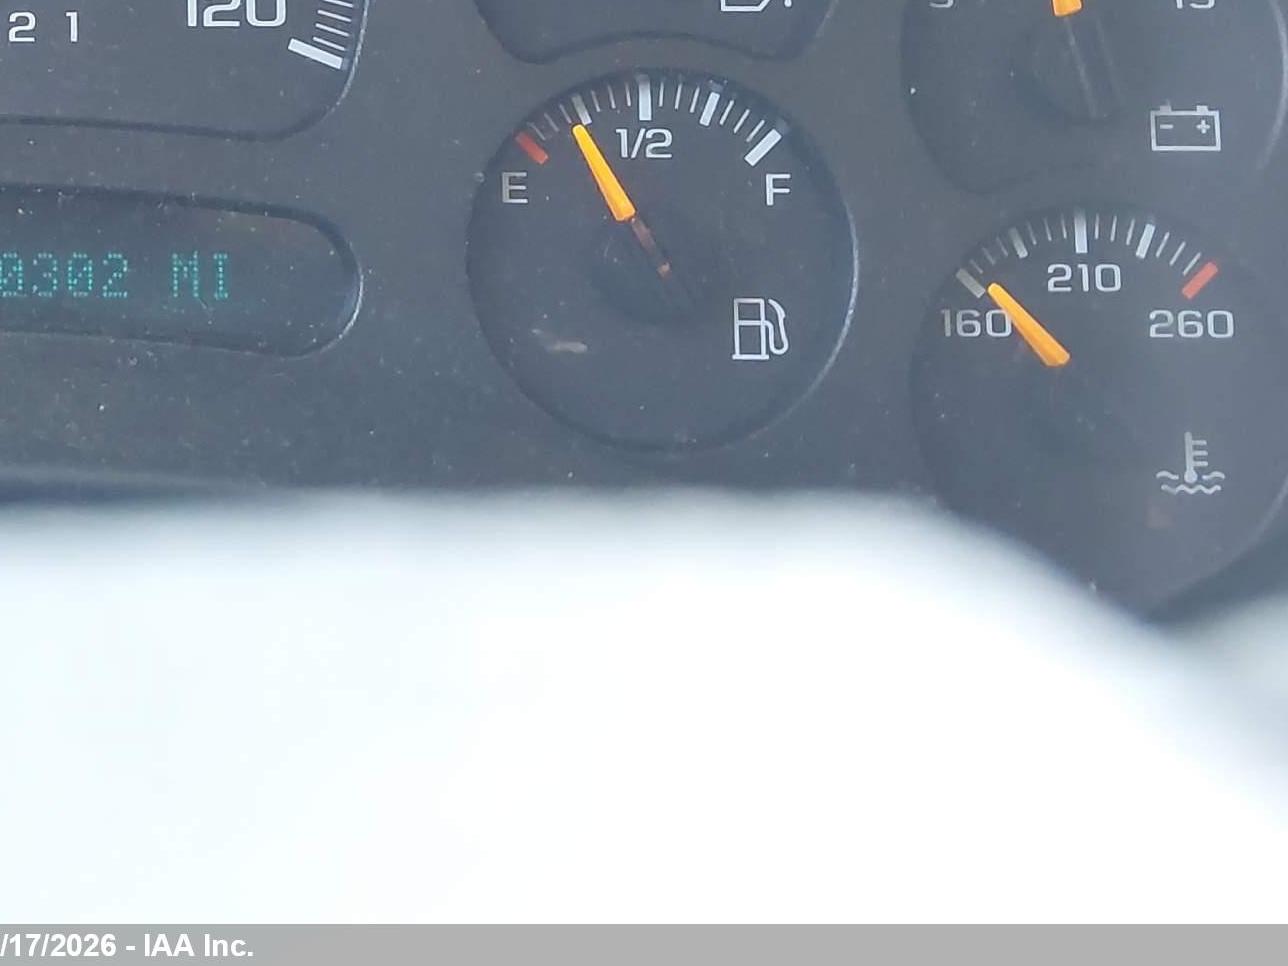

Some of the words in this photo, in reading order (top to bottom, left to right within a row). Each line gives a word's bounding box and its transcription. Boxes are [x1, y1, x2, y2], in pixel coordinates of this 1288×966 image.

[8, 11, 36, 43] 2
[65, 11, 78, 43] 1
[615, 127, 673, 159] 1/2
[502, 172, 529, 204] E
[765, 173, 791, 206] F
[171, 251, 230, 298] MI
[1047, 263, 1122, 292] 210
[940, 309, 1012, 338] 160
[1149, 309, 1234, 339] 260
